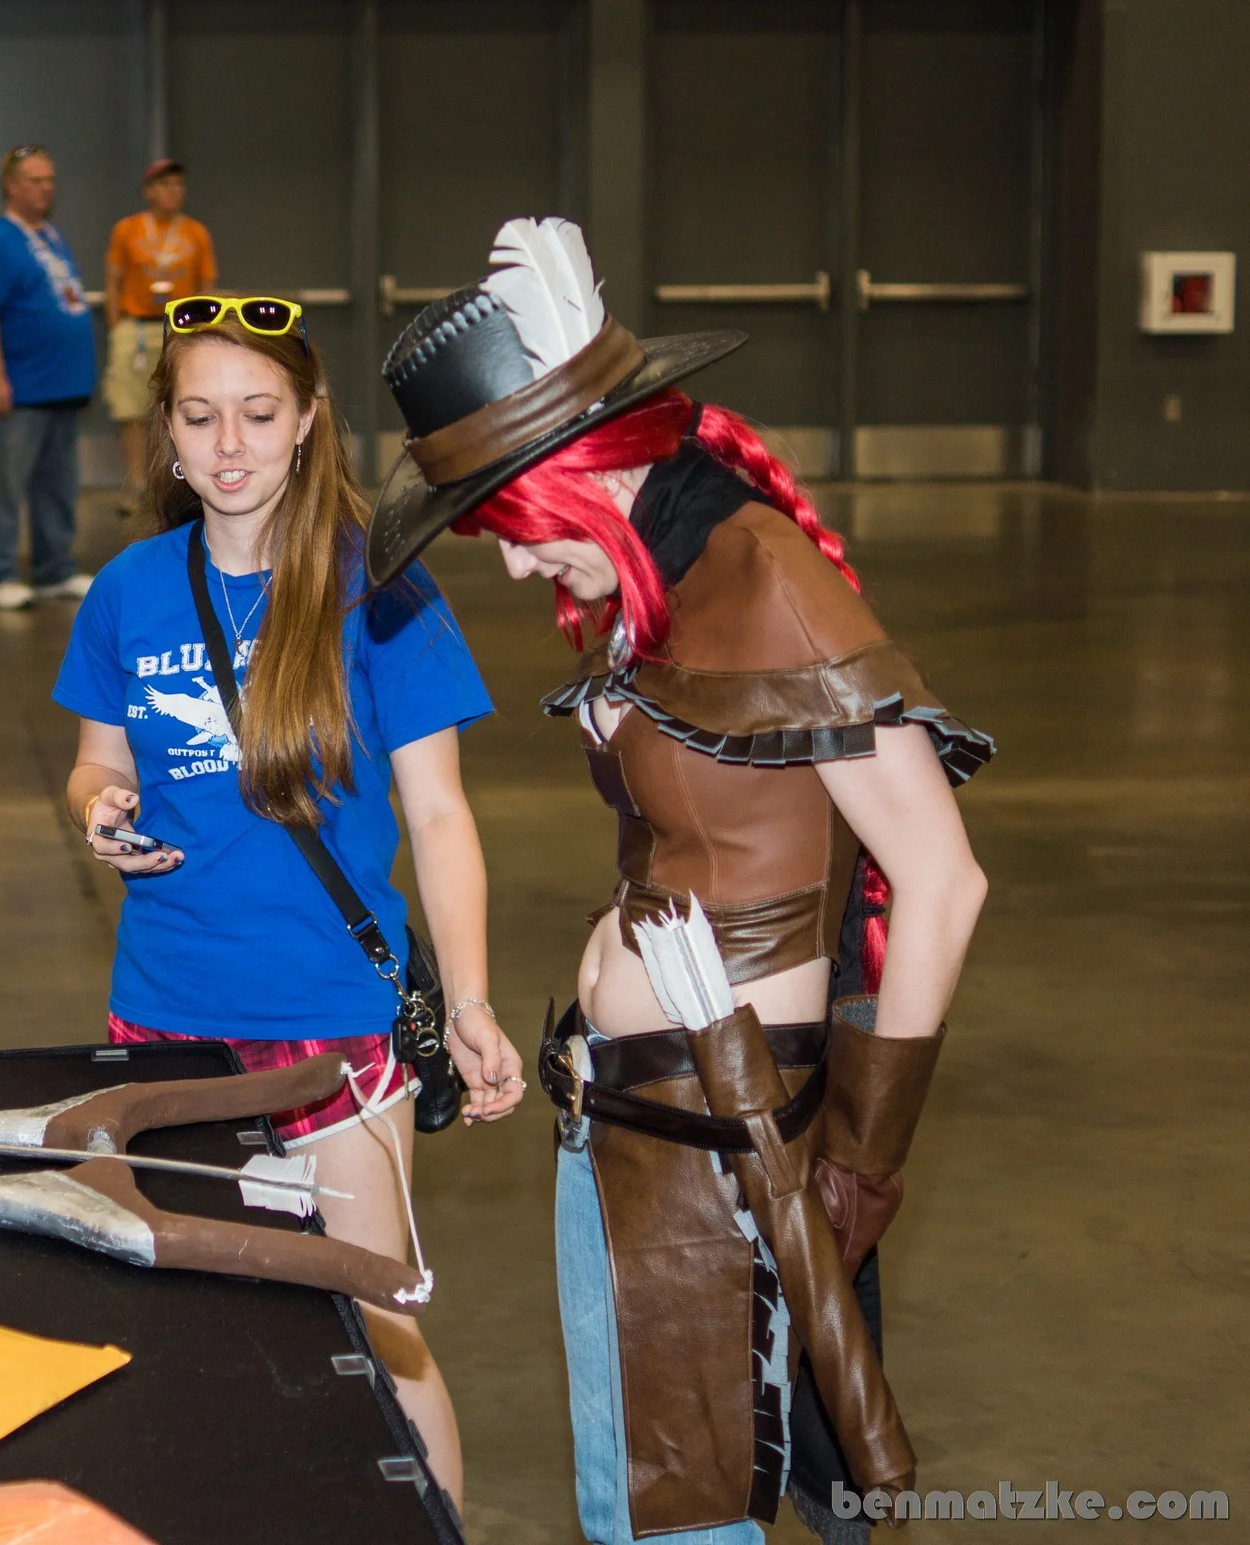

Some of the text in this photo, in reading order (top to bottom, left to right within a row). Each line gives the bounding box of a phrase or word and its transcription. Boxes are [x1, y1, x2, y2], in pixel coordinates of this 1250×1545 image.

[136, 642, 212, 679] BLU
[127, 704, 148, 719] EST.
[167, 747, 216, 757] OUTPOST
[167, 758, 229, 781] BLOOD
